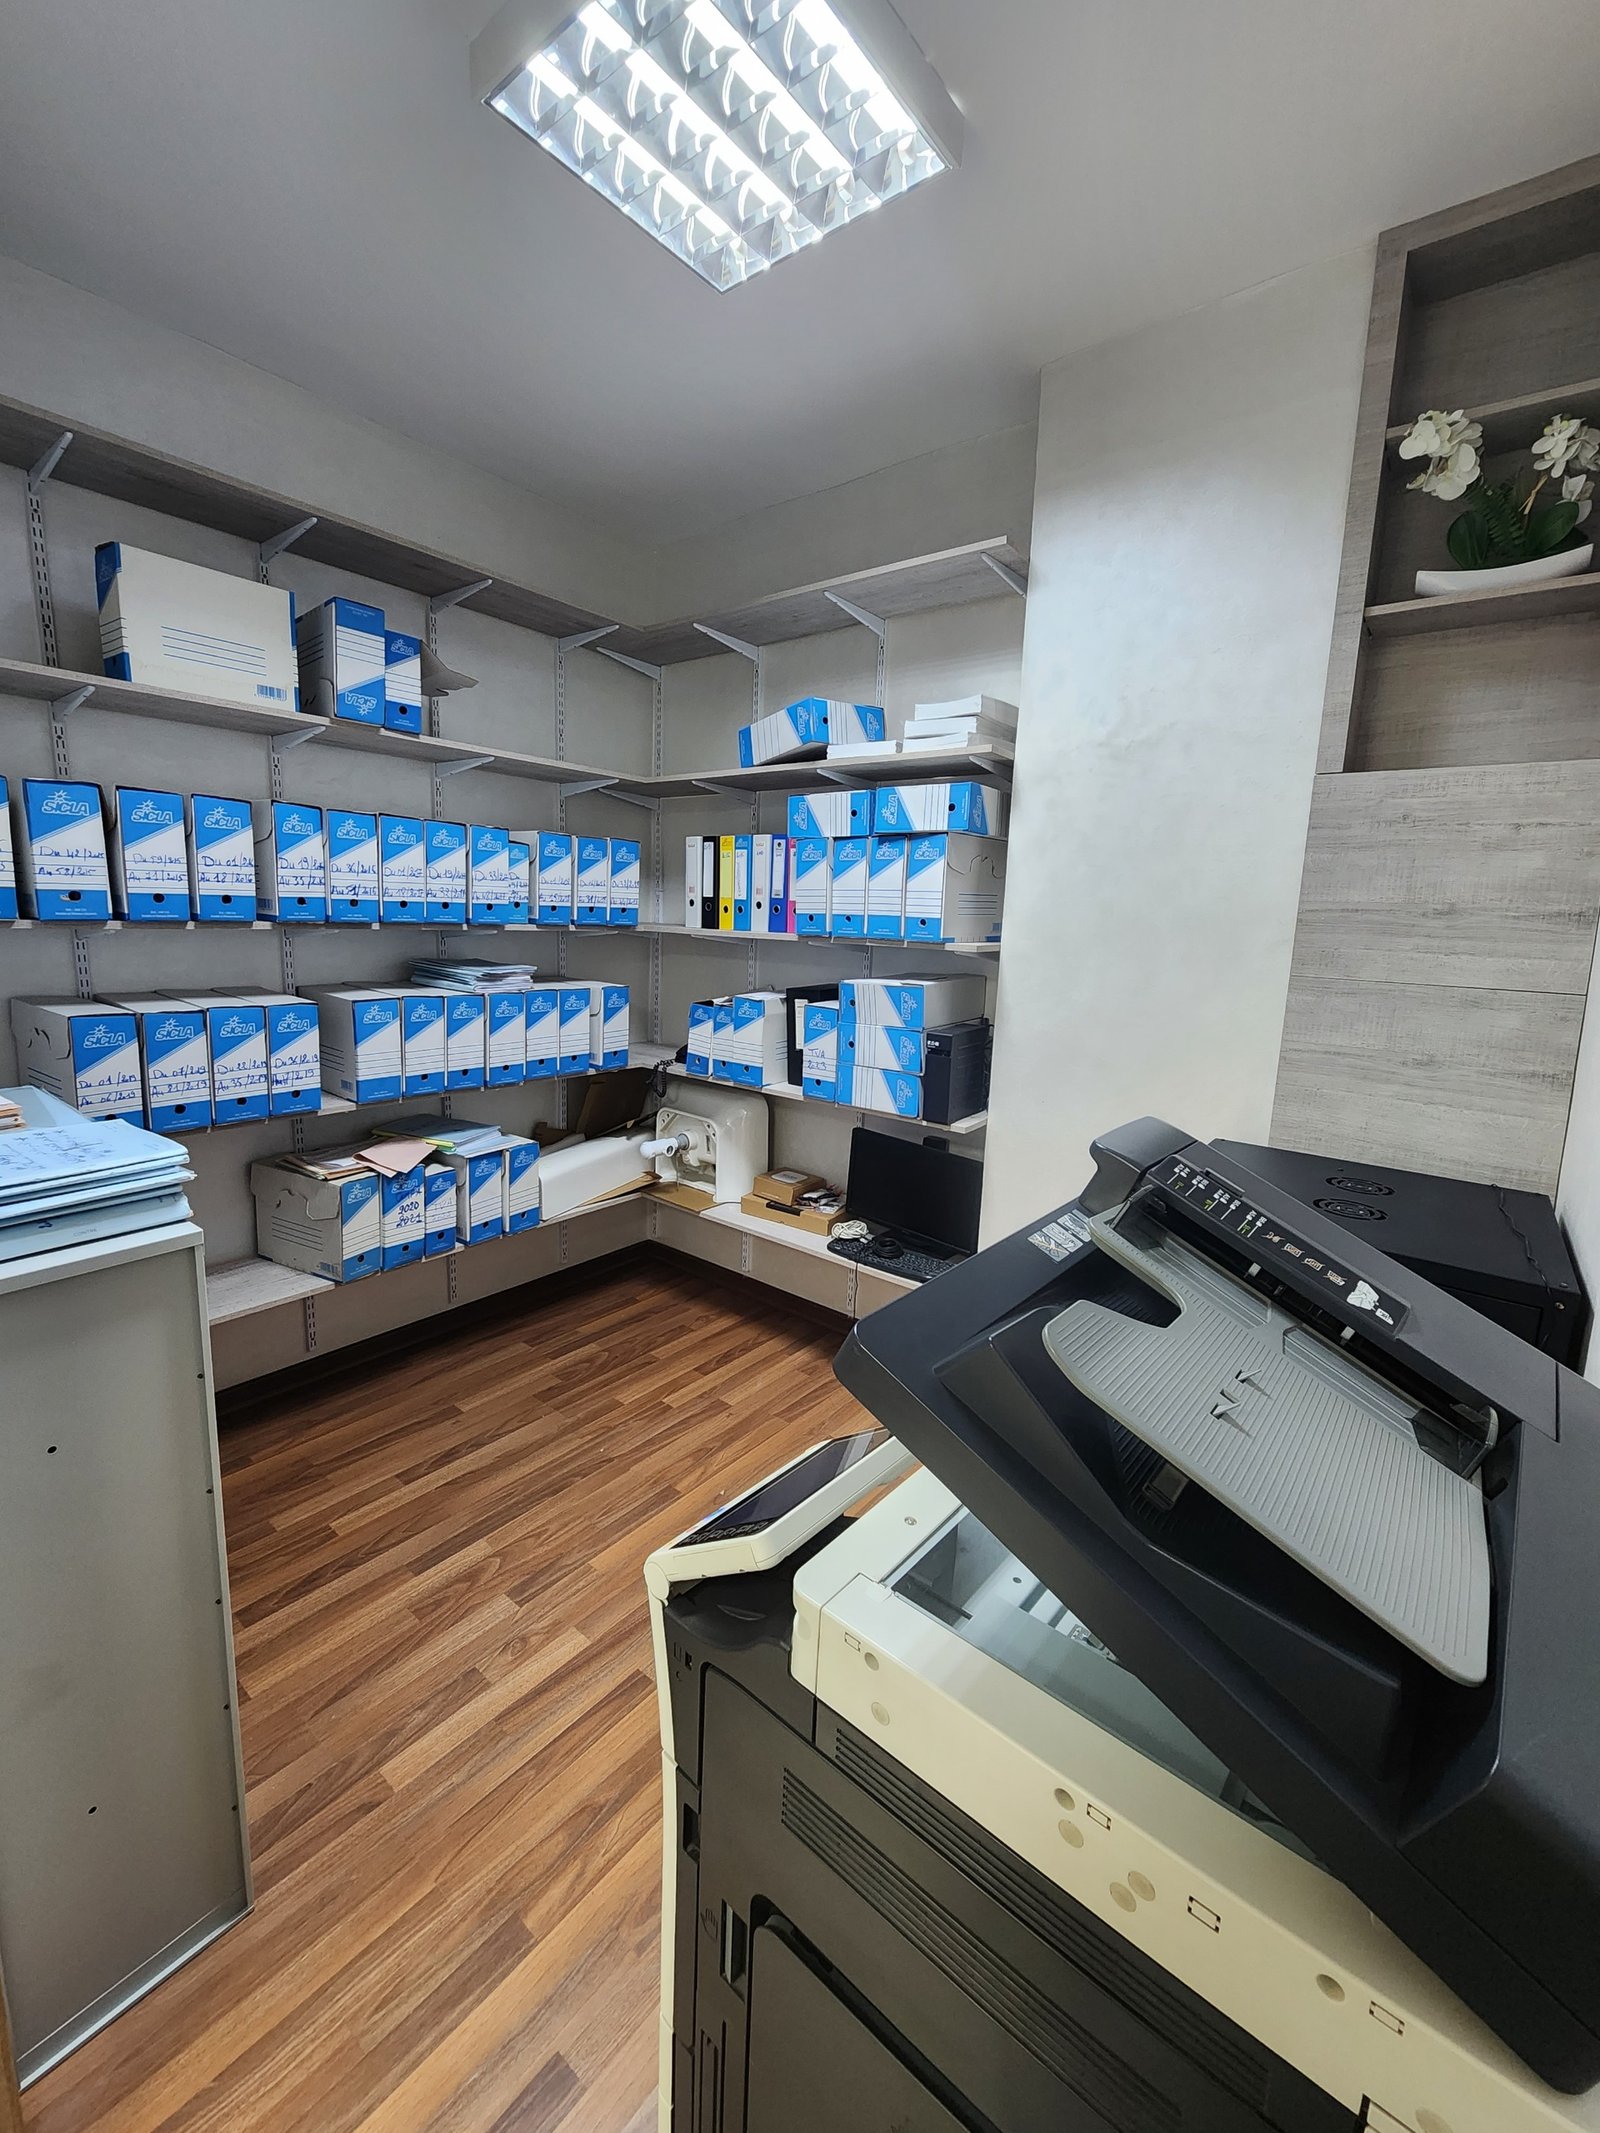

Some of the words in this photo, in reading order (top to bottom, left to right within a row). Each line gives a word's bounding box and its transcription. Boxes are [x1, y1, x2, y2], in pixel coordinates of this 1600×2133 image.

[42, 800, 89, 815] SICLA
[131, 809, 173, 824] SICLA
[204, 816, 241, 830] SICLA
[282, 822, 314, 835] SICLA
[337, 827, 368, 839] SICLA
[39, 846, 60, 856] Du
[202, 856, 221, 866] Du
[279, 857, 294, 869] Du
[363, 1010, 393, 1024] SICLA
[220, 1022, 255, 1037] SICLA
[277, 1019, 310, 1032] SICLA
[155, 1026, 194, 1041] SICLA
[84, 1033, 125, 1048] SICLA
[153, 1070, 168, 1079] Du
[217, 1065, 233, 1075] Du
[79, 1080, 92, 1088] Du
[398, 1201, 420, 1215] 2020
